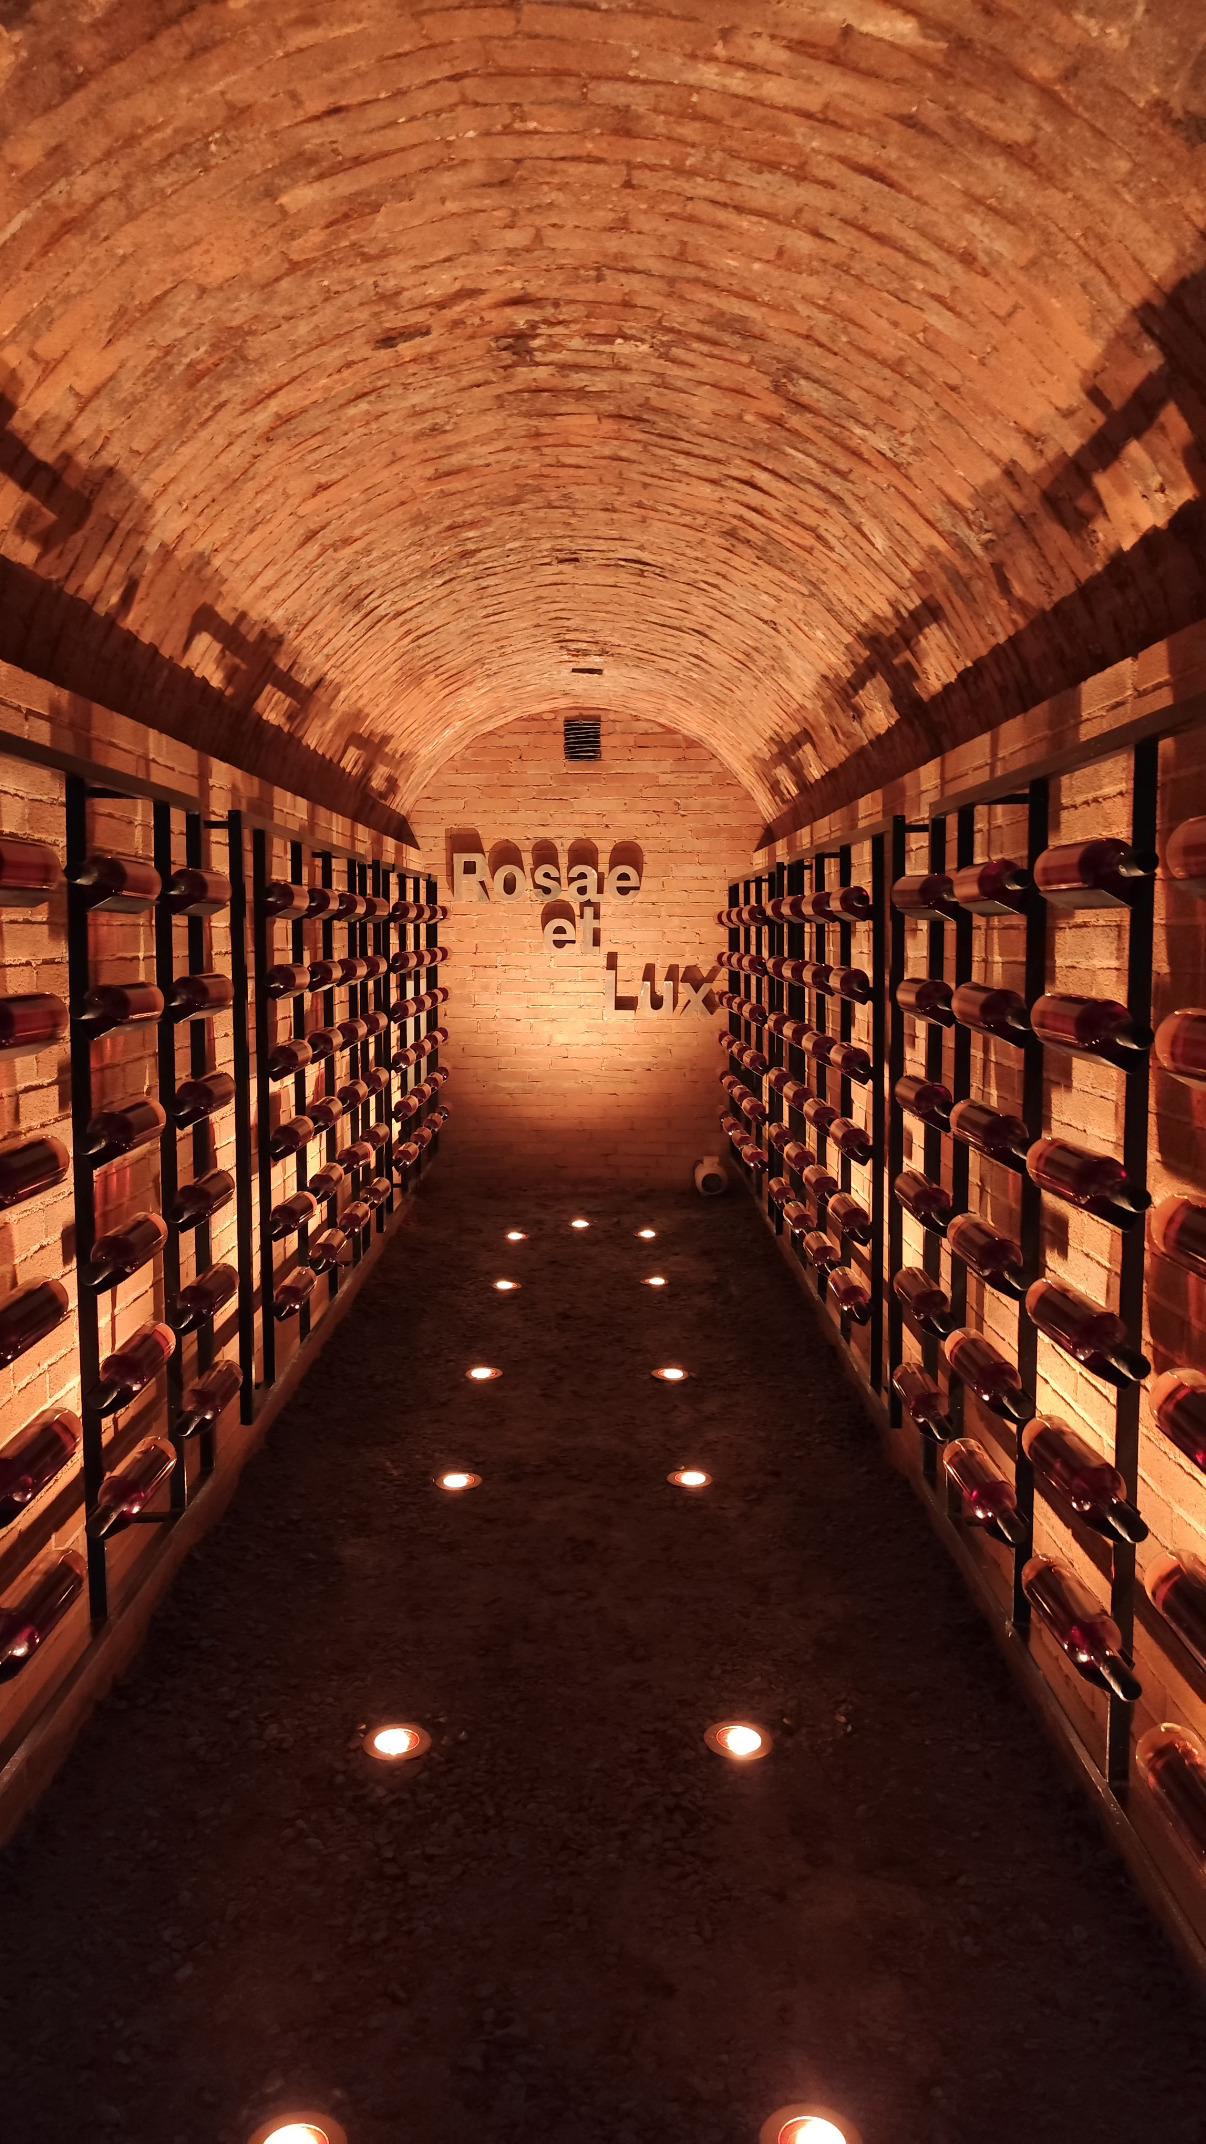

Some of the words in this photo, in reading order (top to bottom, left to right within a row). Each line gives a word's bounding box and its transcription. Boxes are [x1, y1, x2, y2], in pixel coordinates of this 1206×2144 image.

[452, 852, 642, 902] Rosae
[543, 906, 601, 953] et
[604, 969, 718, 1016] Lux
